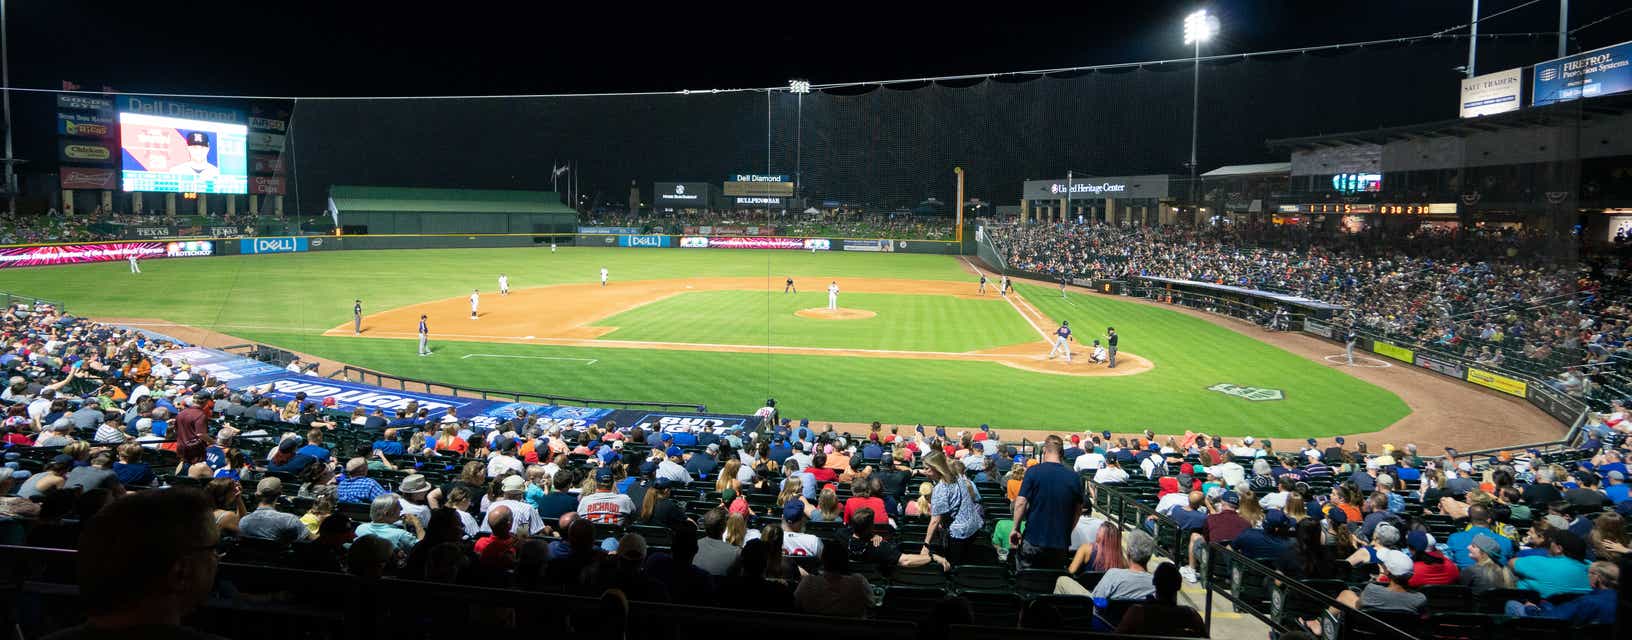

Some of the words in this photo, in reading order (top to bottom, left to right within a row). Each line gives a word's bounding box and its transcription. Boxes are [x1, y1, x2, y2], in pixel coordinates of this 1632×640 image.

[1564, 53, 1612, 71] FIRETROL
[1599, 60, 1629, 72] Systems
[128, 98, 163, 113] Dell
[168, 104, 236, 120] Diamond
[737, 174, 750, 182] Dell
[751, 174, 781, 182] Diamond
[1058, 184, 1077, 193] Uned
[1077, 183, 1102, 194] Heritage
[1103, 182, 1125, 192] Center
[137, 227, 169, 236] TEXAS
[659, 416, 725, 427] BUD
[587, 502, 619, 512] RICHARD
